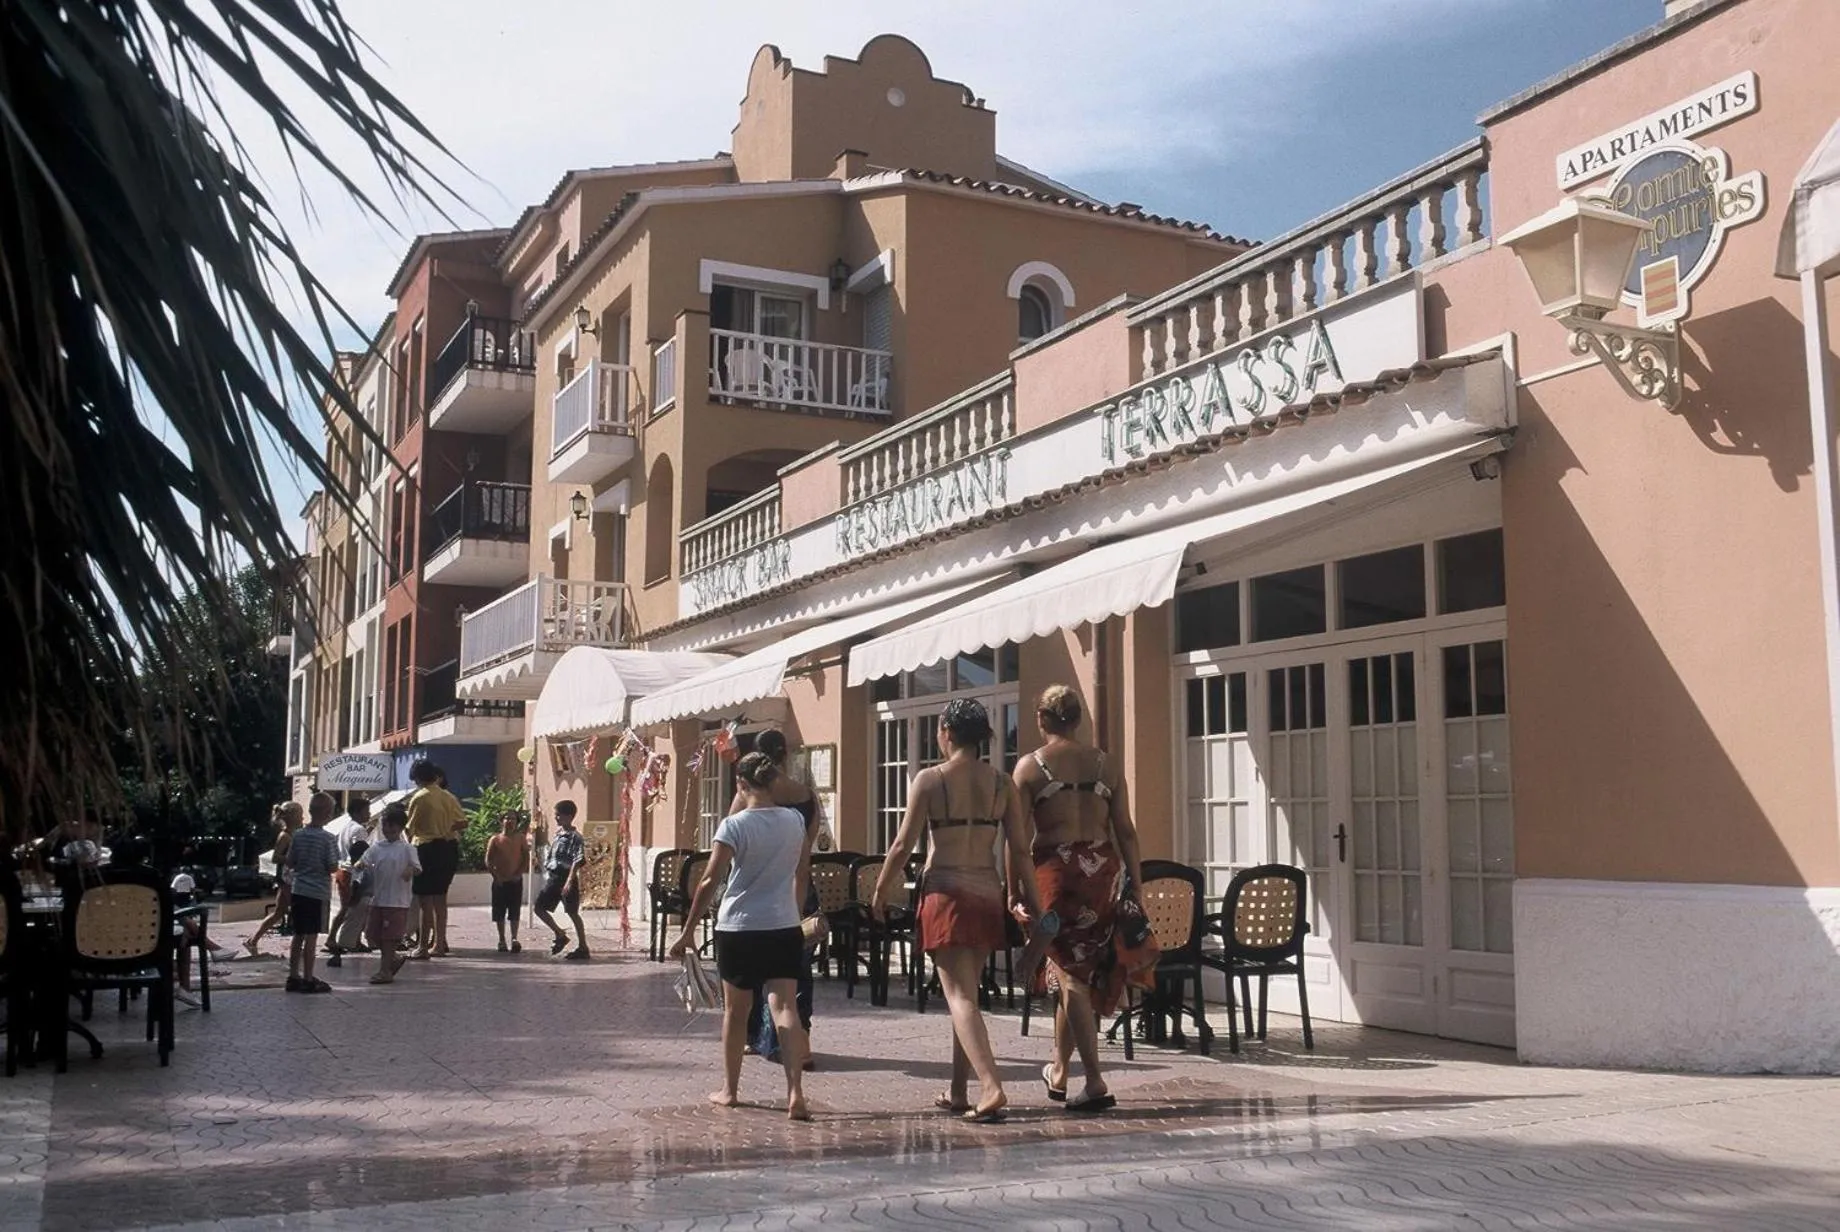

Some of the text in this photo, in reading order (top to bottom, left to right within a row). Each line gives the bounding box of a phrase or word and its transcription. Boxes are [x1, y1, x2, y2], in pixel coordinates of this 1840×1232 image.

[1563, 83, 1748, 181] APARTAMENTS
[753, 539, 792, 589] BAR
[835, 447, 1012, 558] RESTAURANT
[1094, 319, 1345, 465] TERRASSA
[323, 755, 387, 771] RESTAURANT
[346, 764, 366, 772] BAR
